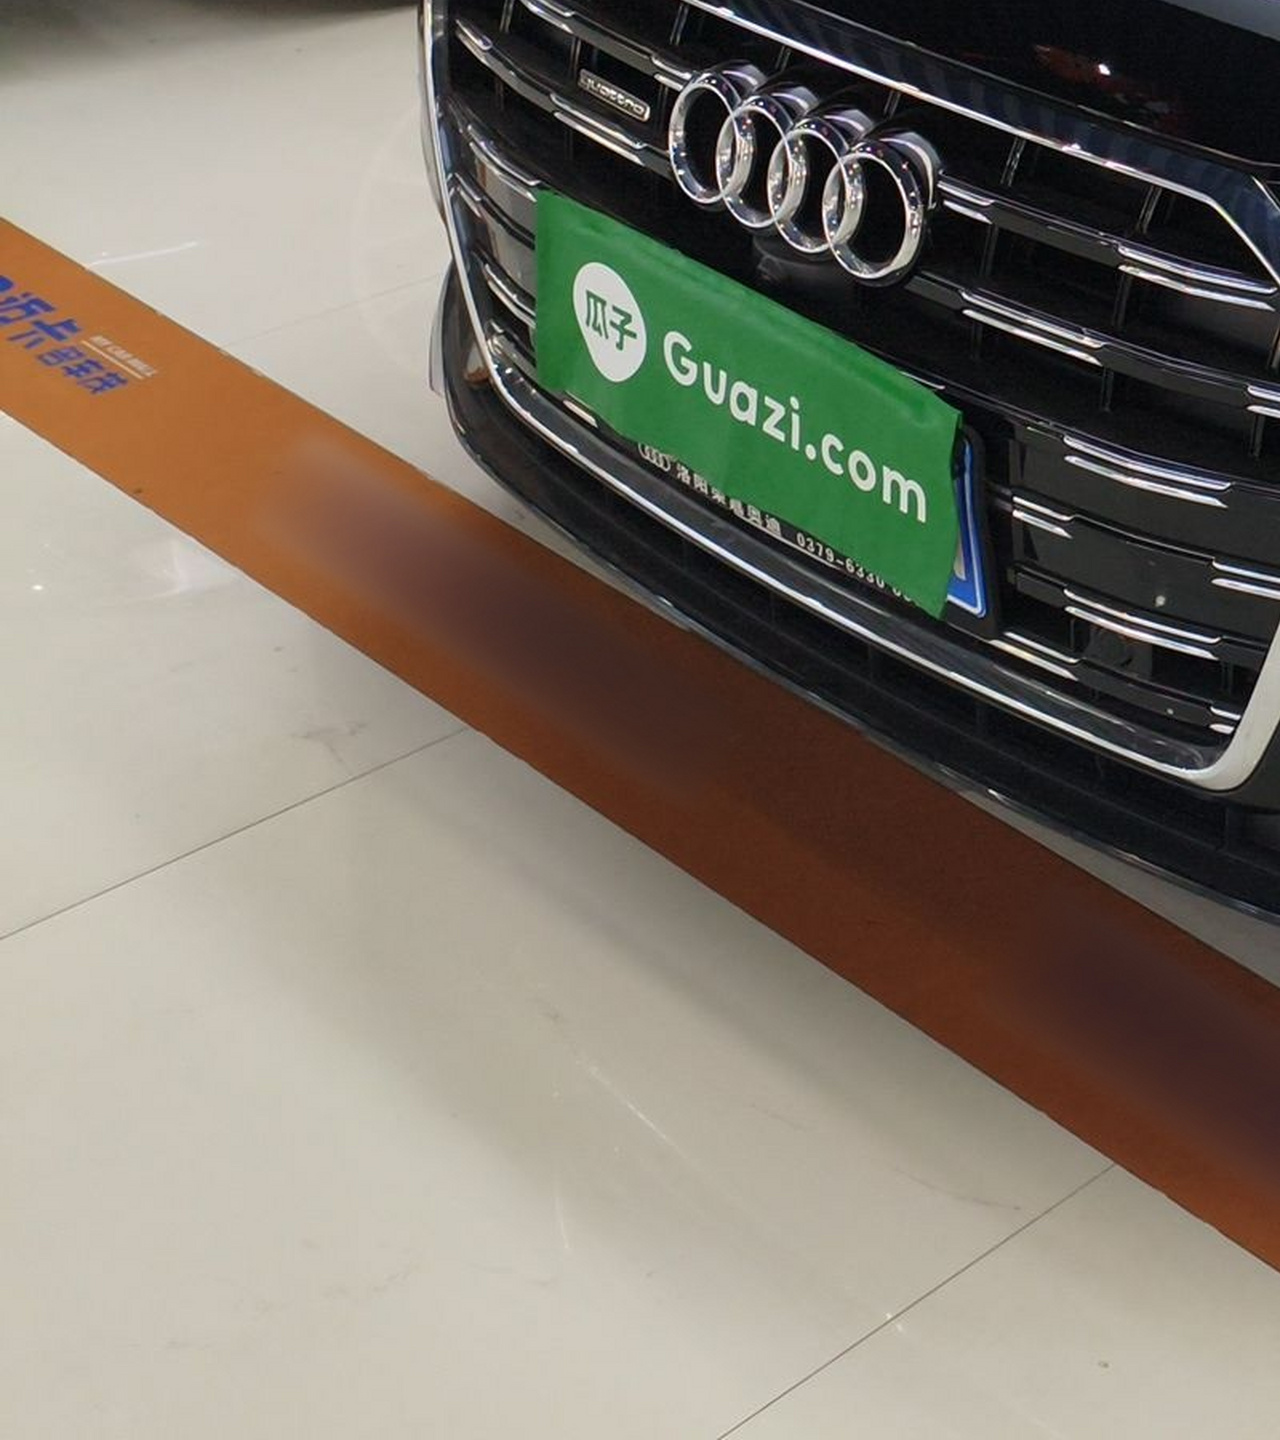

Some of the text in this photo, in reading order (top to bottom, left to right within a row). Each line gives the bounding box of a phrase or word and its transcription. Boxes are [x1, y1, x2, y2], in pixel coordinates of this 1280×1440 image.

[581, 78, 645, 117] quattro
[585, 288, 637, 351] 瓜子
[663, 331, 927, 524] Guazi.com
